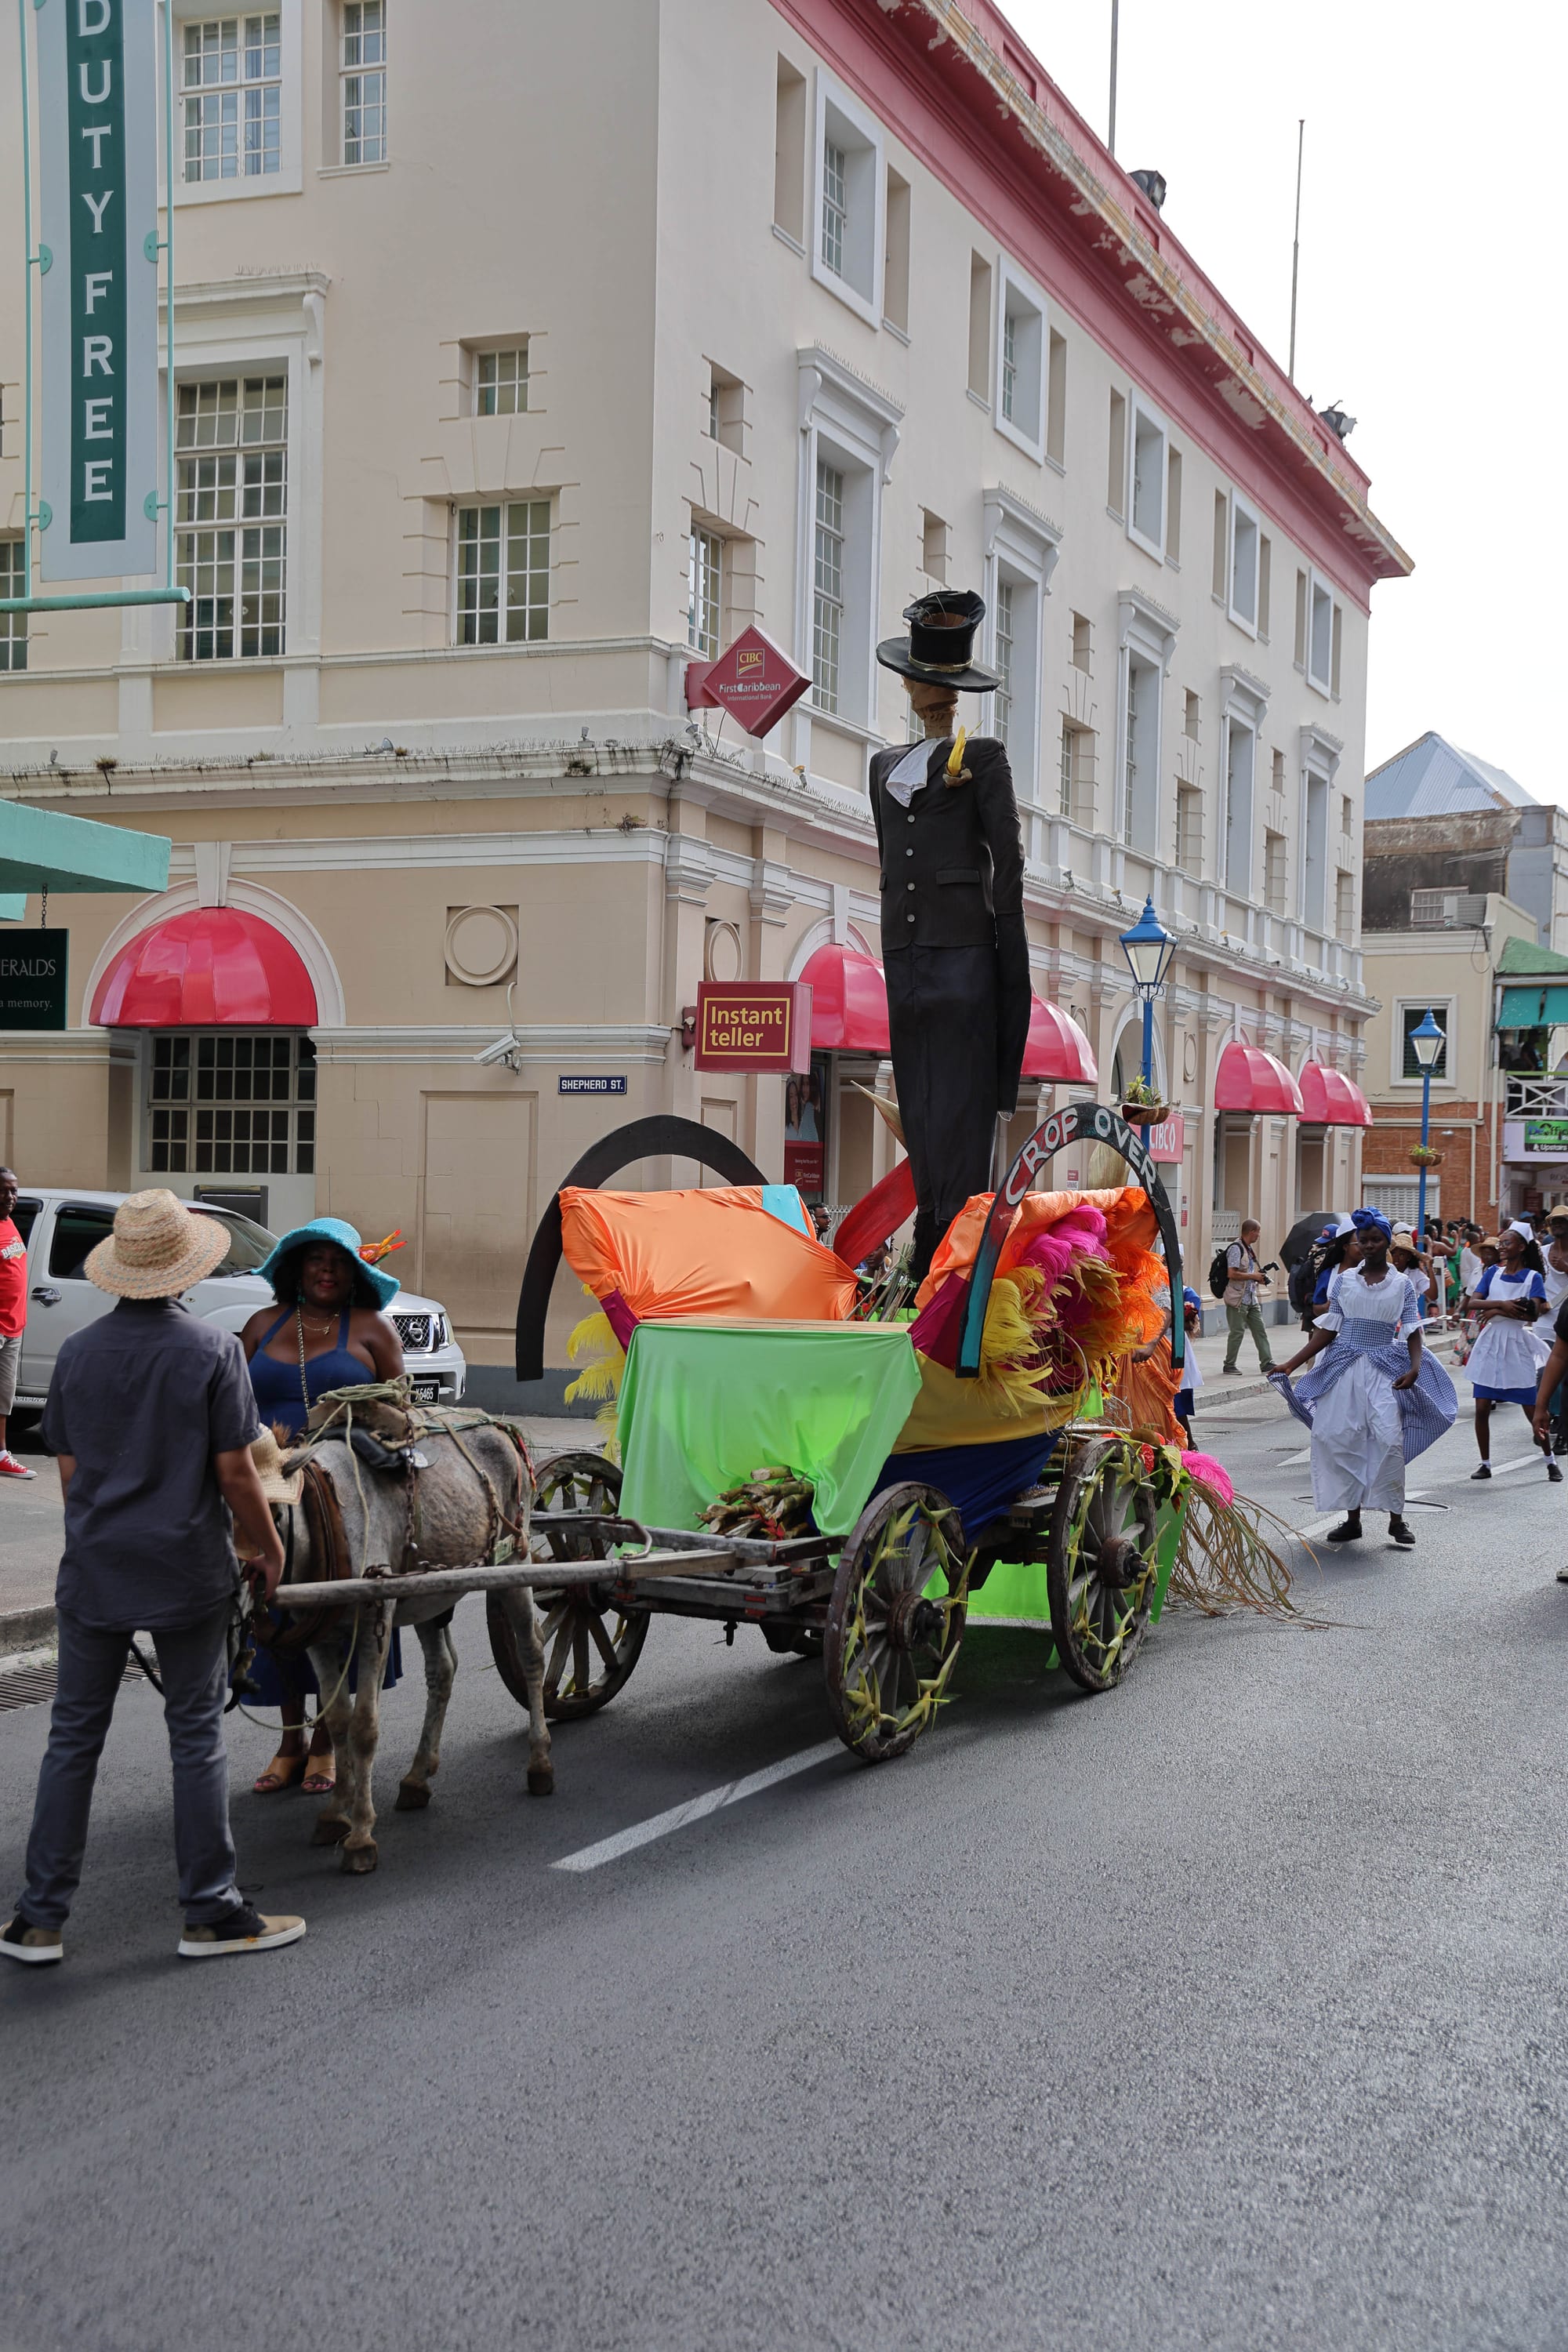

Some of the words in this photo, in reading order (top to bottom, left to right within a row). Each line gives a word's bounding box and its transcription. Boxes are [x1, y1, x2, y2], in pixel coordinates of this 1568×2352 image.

[78, 0, 114, 234] DUTY
[82, 270, 115, 502] FREE
[739, 652, 763, 663] CIBC
[719, 681, 781, 693] FirstCaribbean
[0, 959, 56, 976] ERALDS
[8, 1000, 53, 1011] memory.
[711, 1006, 782, 1025] Instant
[710, 1027, 764, 1047] teller
[561, 1080, 607, 1090] SHEPHERD
[611, 1080, 623, 1090] ST.
[1006, 1108, 1078, 1205] CROP
[1094, 1108, 1156, 1194] OVER
